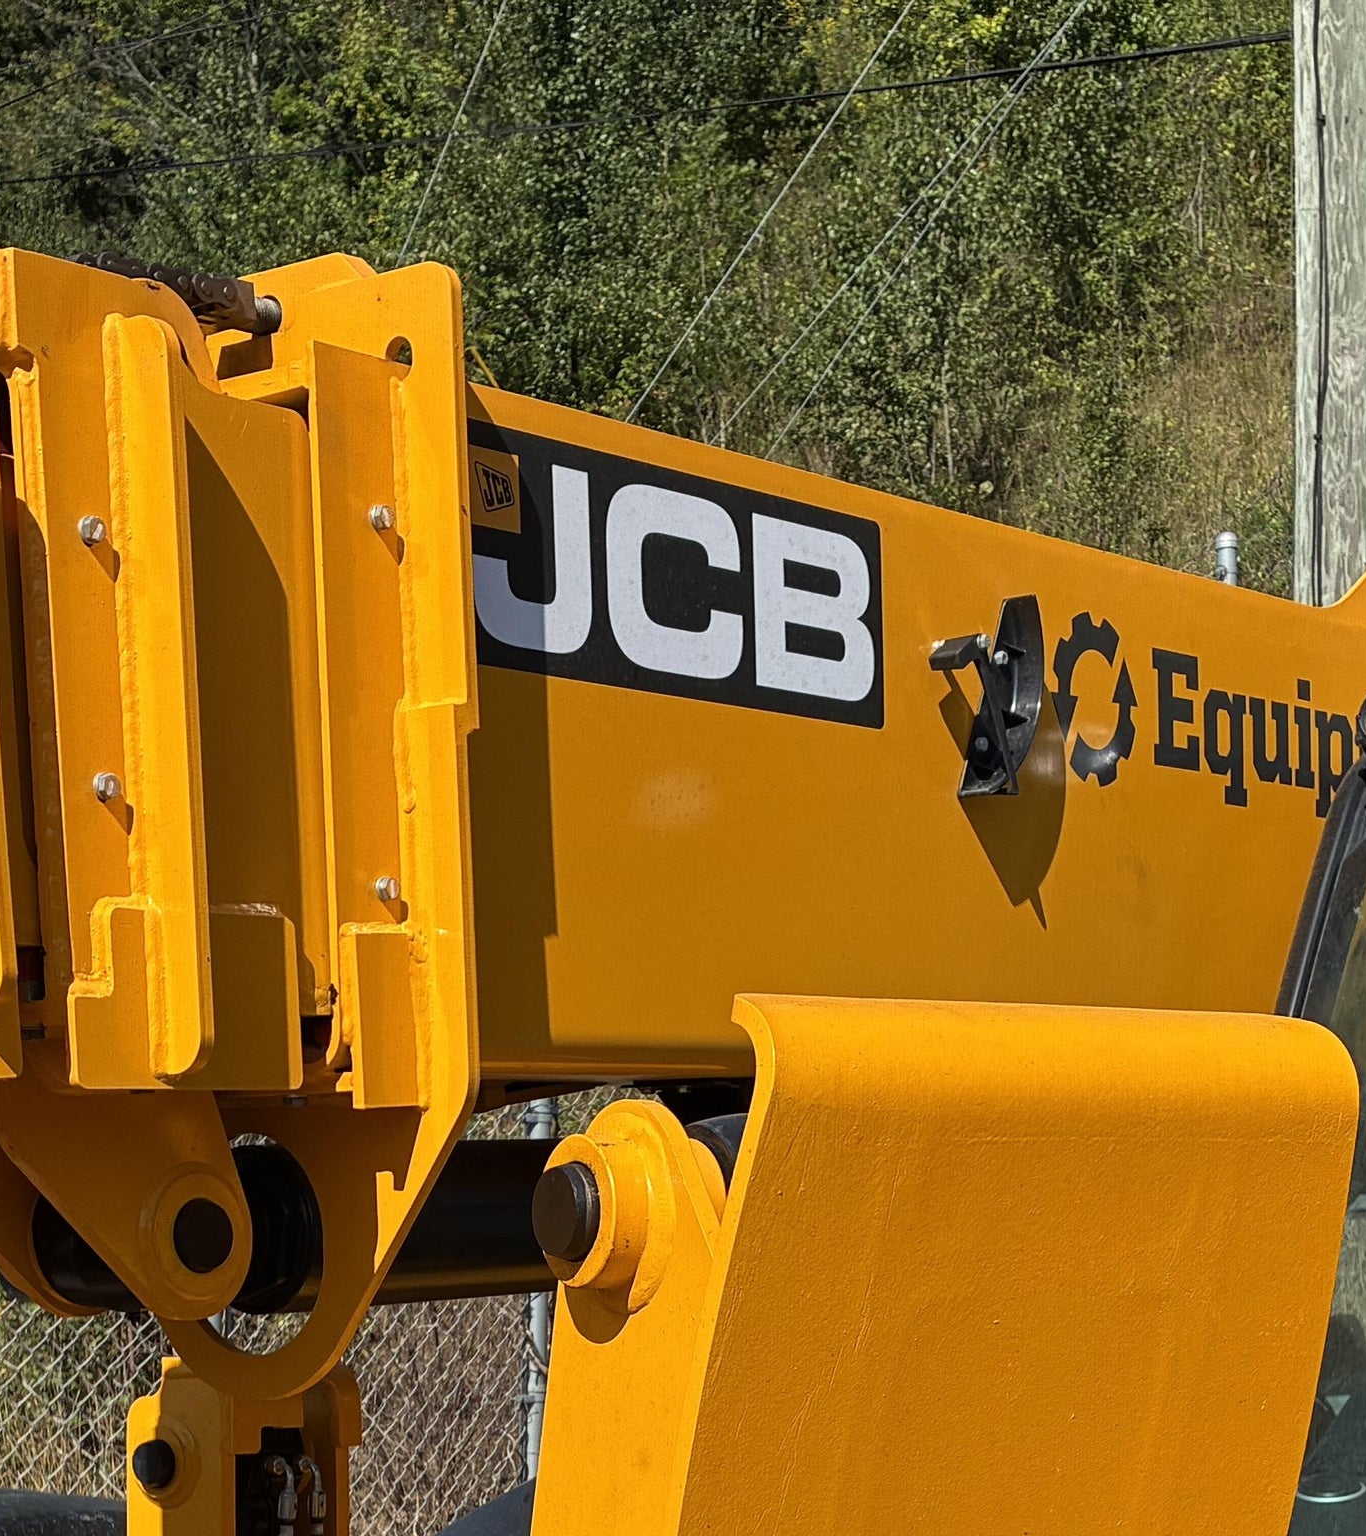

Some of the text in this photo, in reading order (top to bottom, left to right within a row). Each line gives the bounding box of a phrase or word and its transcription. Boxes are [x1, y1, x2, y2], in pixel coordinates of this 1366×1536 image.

[481, 467, 513, 508] JCB
[472, 463, 876, 702] JCB
[1151, 647, 1354, 818] Equip
